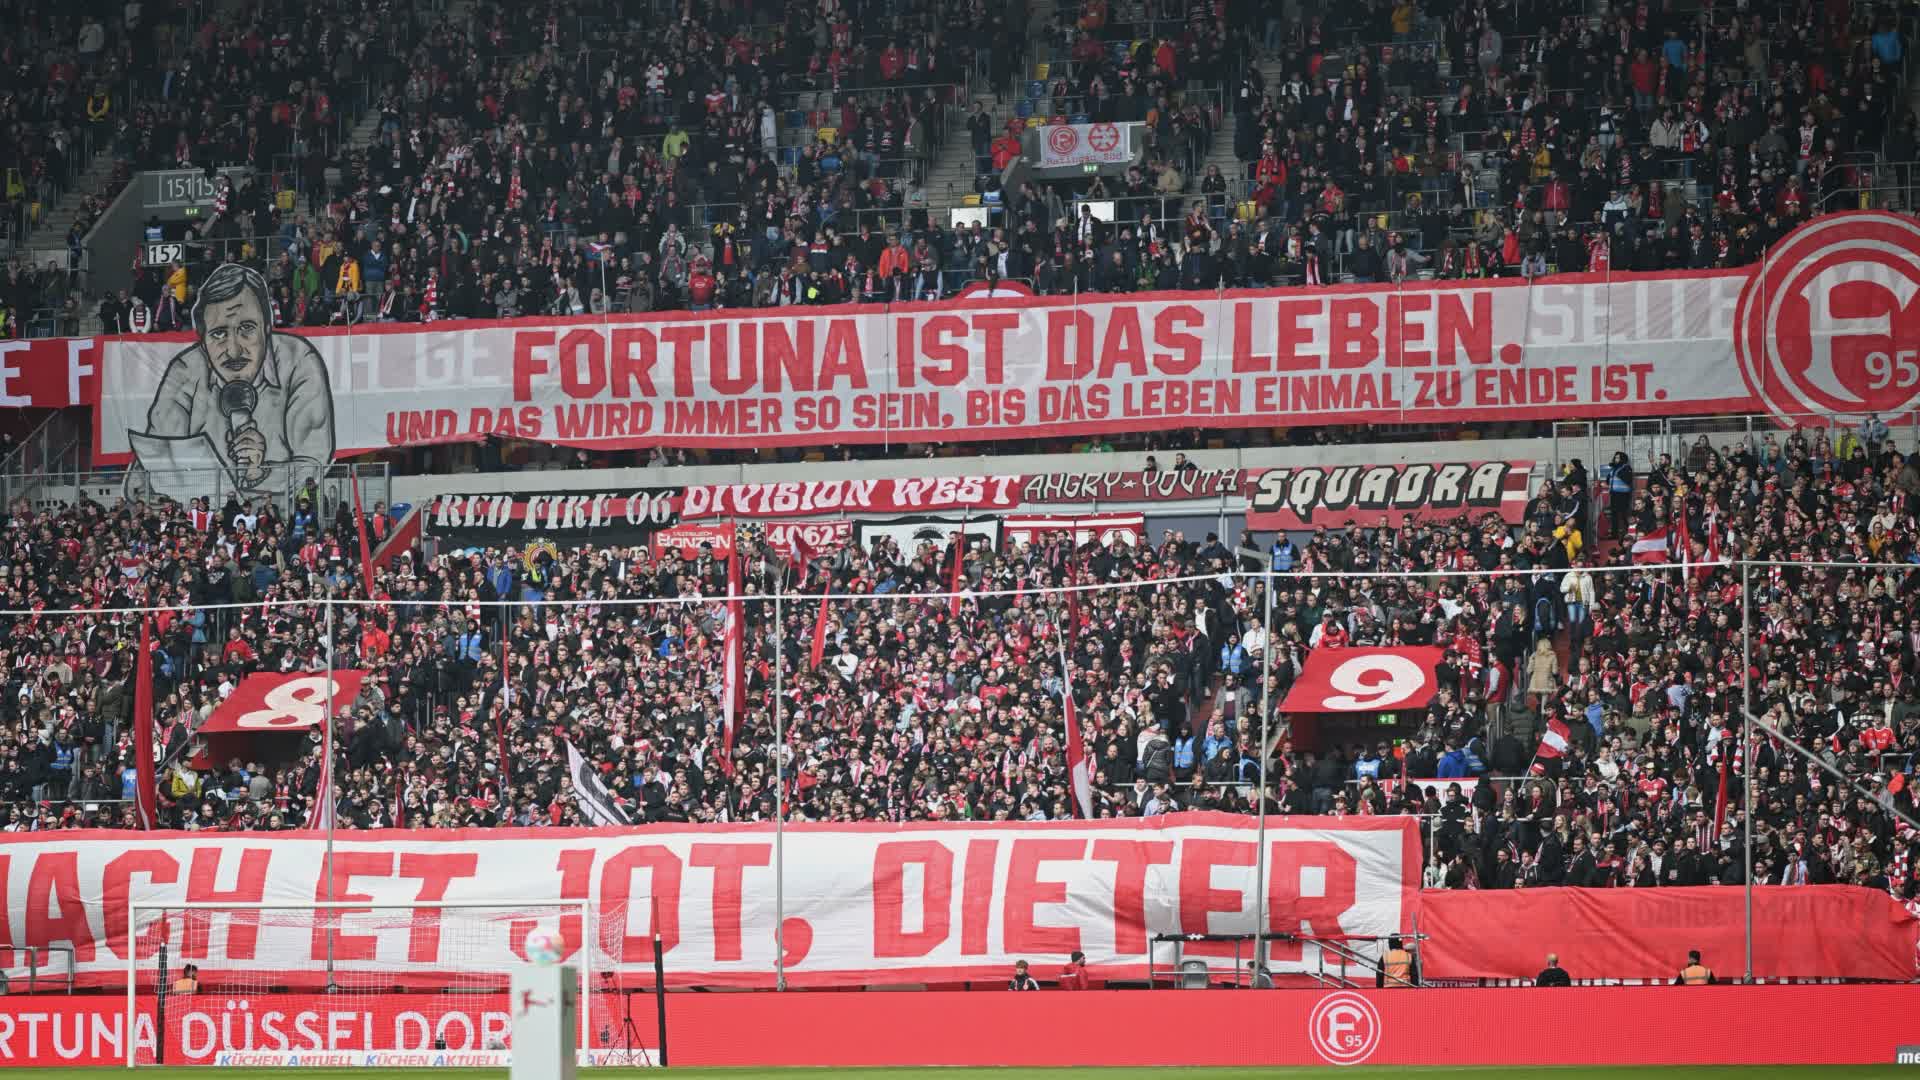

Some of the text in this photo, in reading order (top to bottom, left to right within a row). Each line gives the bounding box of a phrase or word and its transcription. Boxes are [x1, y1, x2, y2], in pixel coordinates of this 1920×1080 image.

[167, 178, 192, 199] 151
[196, 177, 218, 197] 15
[149, 245, 182, 263] 152
[513, 292, 1522, 402] FORTUNA IST DAS LEBEN.
[1864, 349, 1918, 390] 95
[386, 363, 1668, 445] UND DAS WIRD IMMER SO SEIN, BIS DAS LEBEN EINMAL ZU ENDE IST.
[682, 474, 1021, 516] DIVISION WEST
[1023, 468, 1240, 500] ANGRY YOUTH
[1253, 461, 1510, 523] SQUADRA
[435, 490, 675, 530] RED FIRE 06
[767, 523, 849, 546] 40625
[237, 676, 341, 728] 8
[1321, 654, 1426, 711] 9
[0, 838, 1358, 969] ACH ET JOT, DIETER
[181, 1000, 512, 1059] DÜSSELDOR
[1344, 1034, 1363, 1047] 95
[220, 1053, 352, 1066] KÜCHEN AKTUELL
[366, 1053, 500, 1066] KÜCHEN AKTUELL
